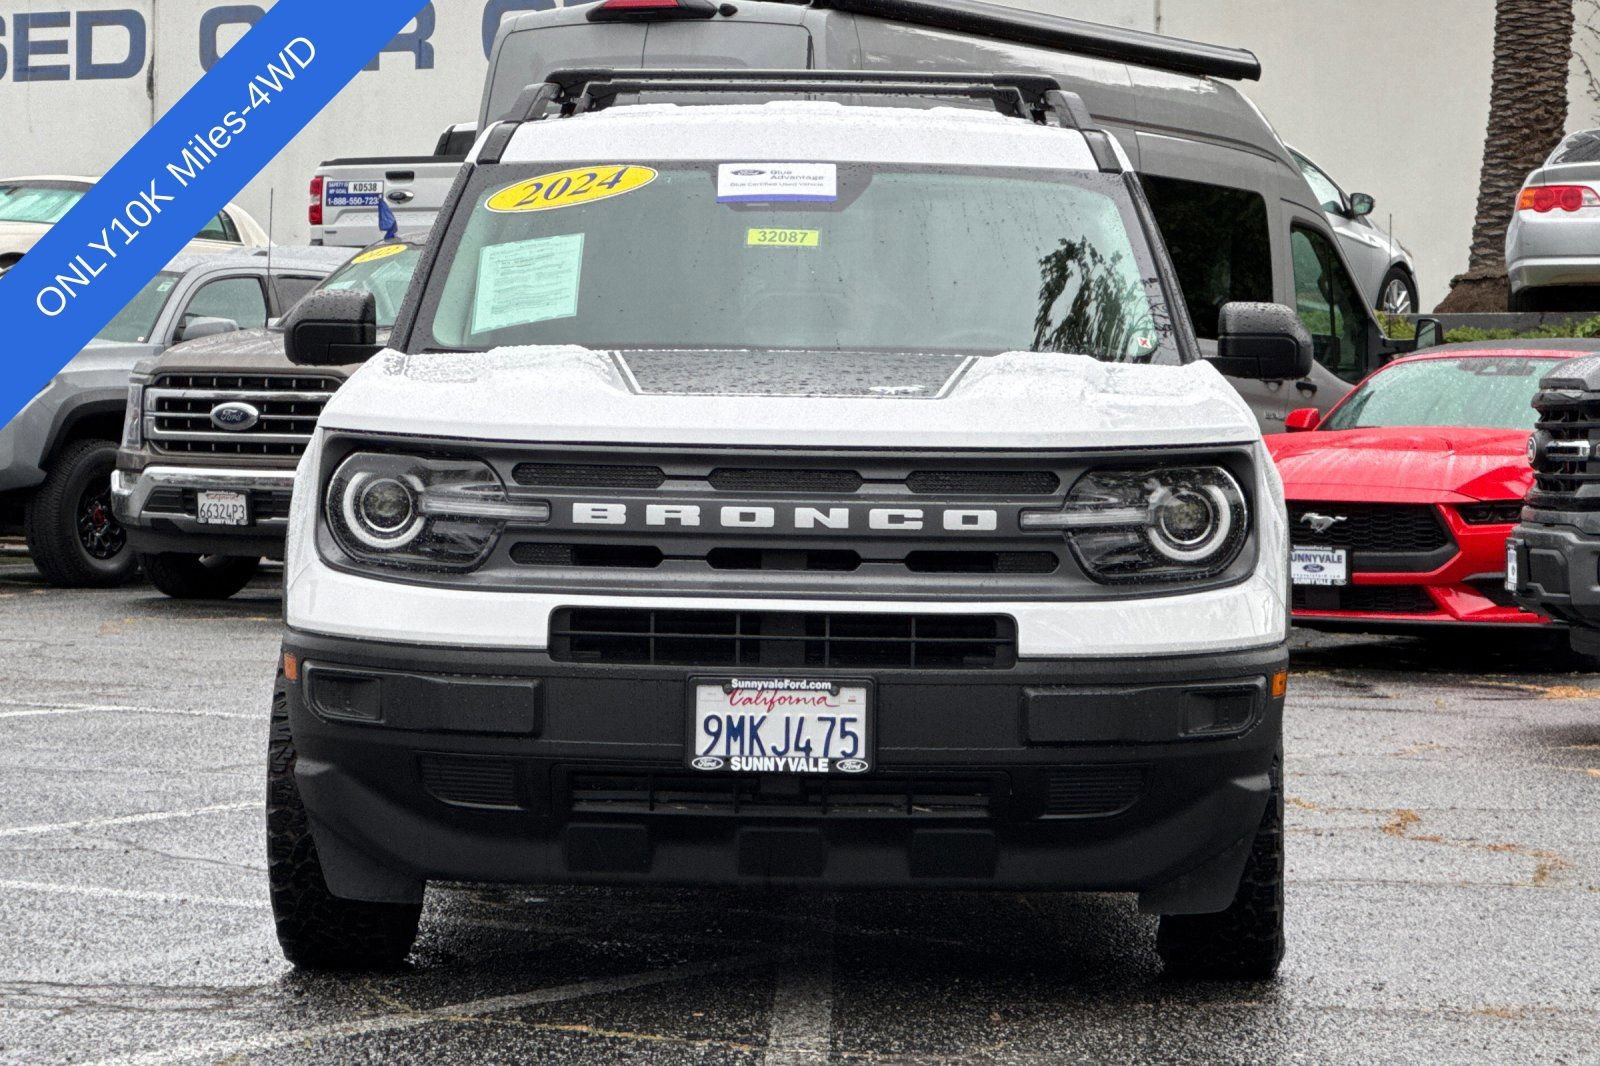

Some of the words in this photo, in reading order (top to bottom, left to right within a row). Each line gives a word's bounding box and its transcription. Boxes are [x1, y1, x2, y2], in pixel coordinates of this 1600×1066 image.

[512, 166, 630, 207] 2024
[328, 197, 379, 205] 1-888-550-723
[757, 230, 809, 243] 32087
[200, 503, 245, 519] 66324P3
[572, 502, 998, 531] BRONCO
[1291, 552, 1343, 564] UNNYVALE
[731, 678, 832, 690] SunnyvaleFord.com
[729, 688, 840, 713] California
[702, 714, 859, 758] 9MKJ475
[730, 756, 829, 772] SUNNYVALE
